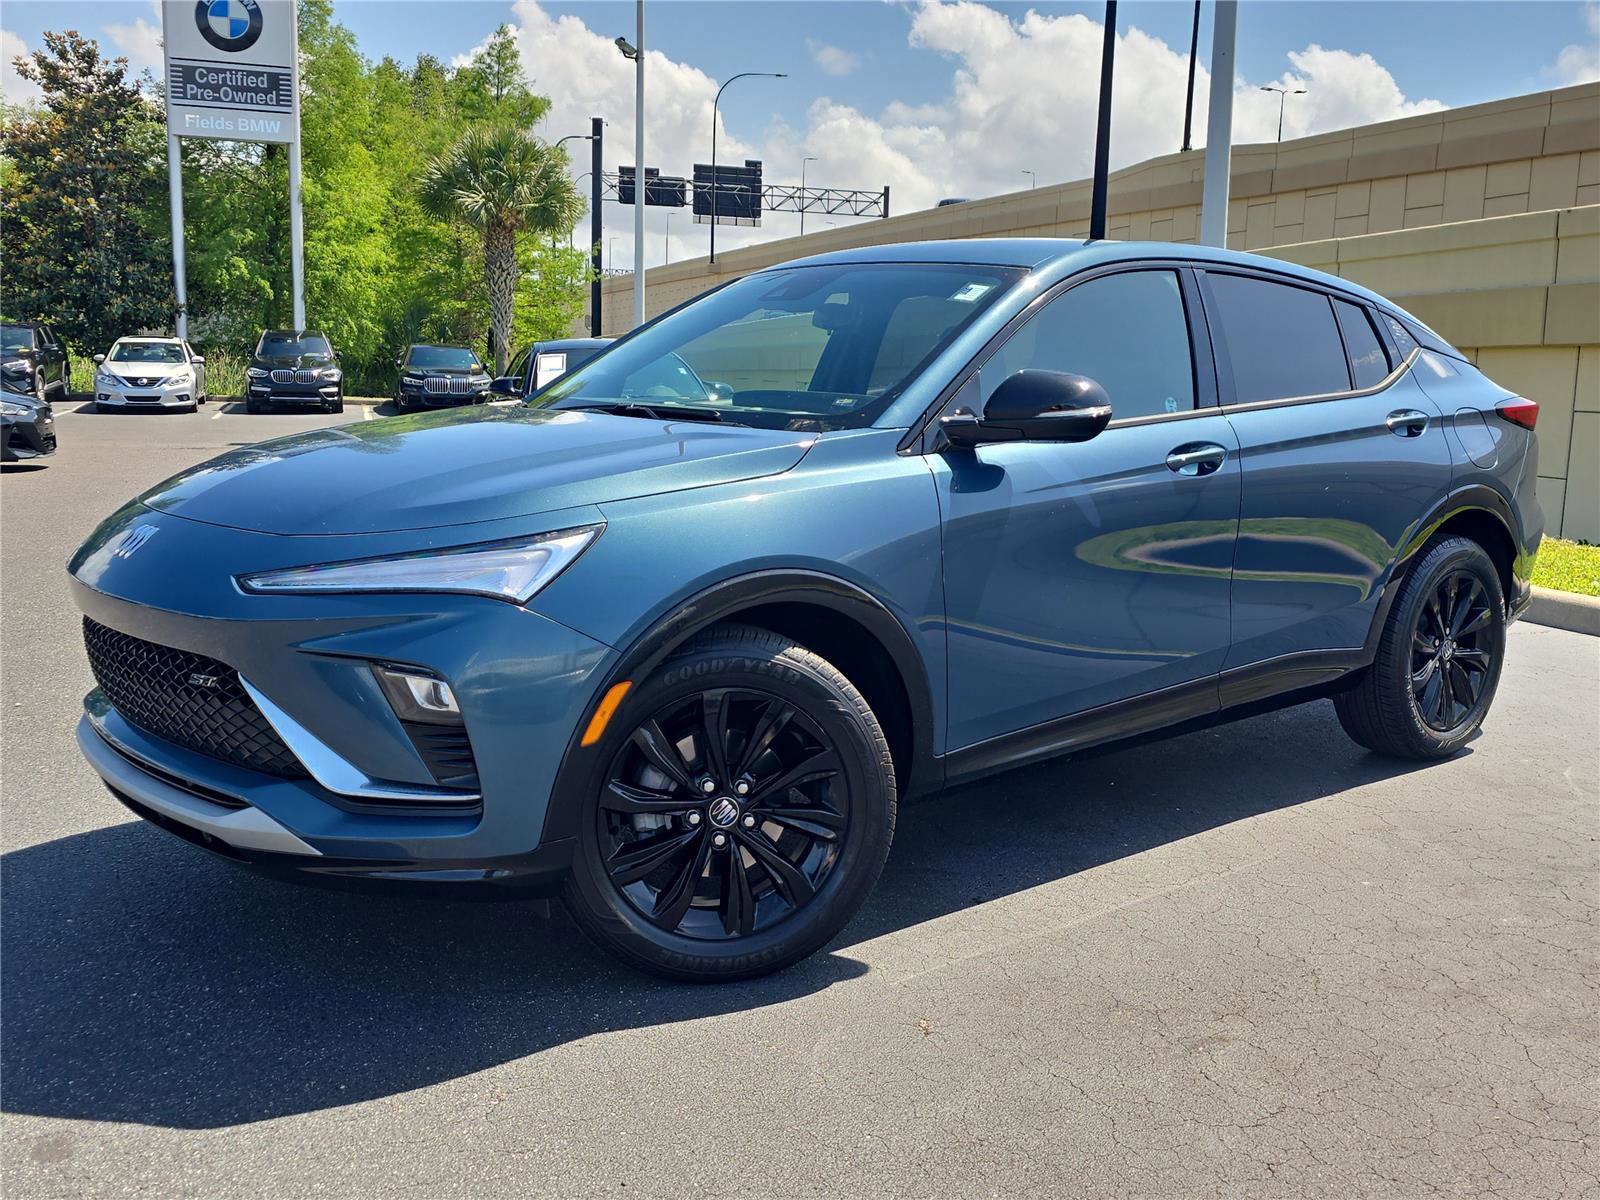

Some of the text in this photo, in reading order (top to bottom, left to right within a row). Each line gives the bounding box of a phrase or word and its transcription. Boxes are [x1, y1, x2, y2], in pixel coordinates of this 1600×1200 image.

[195, 68, 268, 88] Certified
[186, 84, 277, 105] Pre-Owned
[184, 114, 281, 134] Fields BMW
